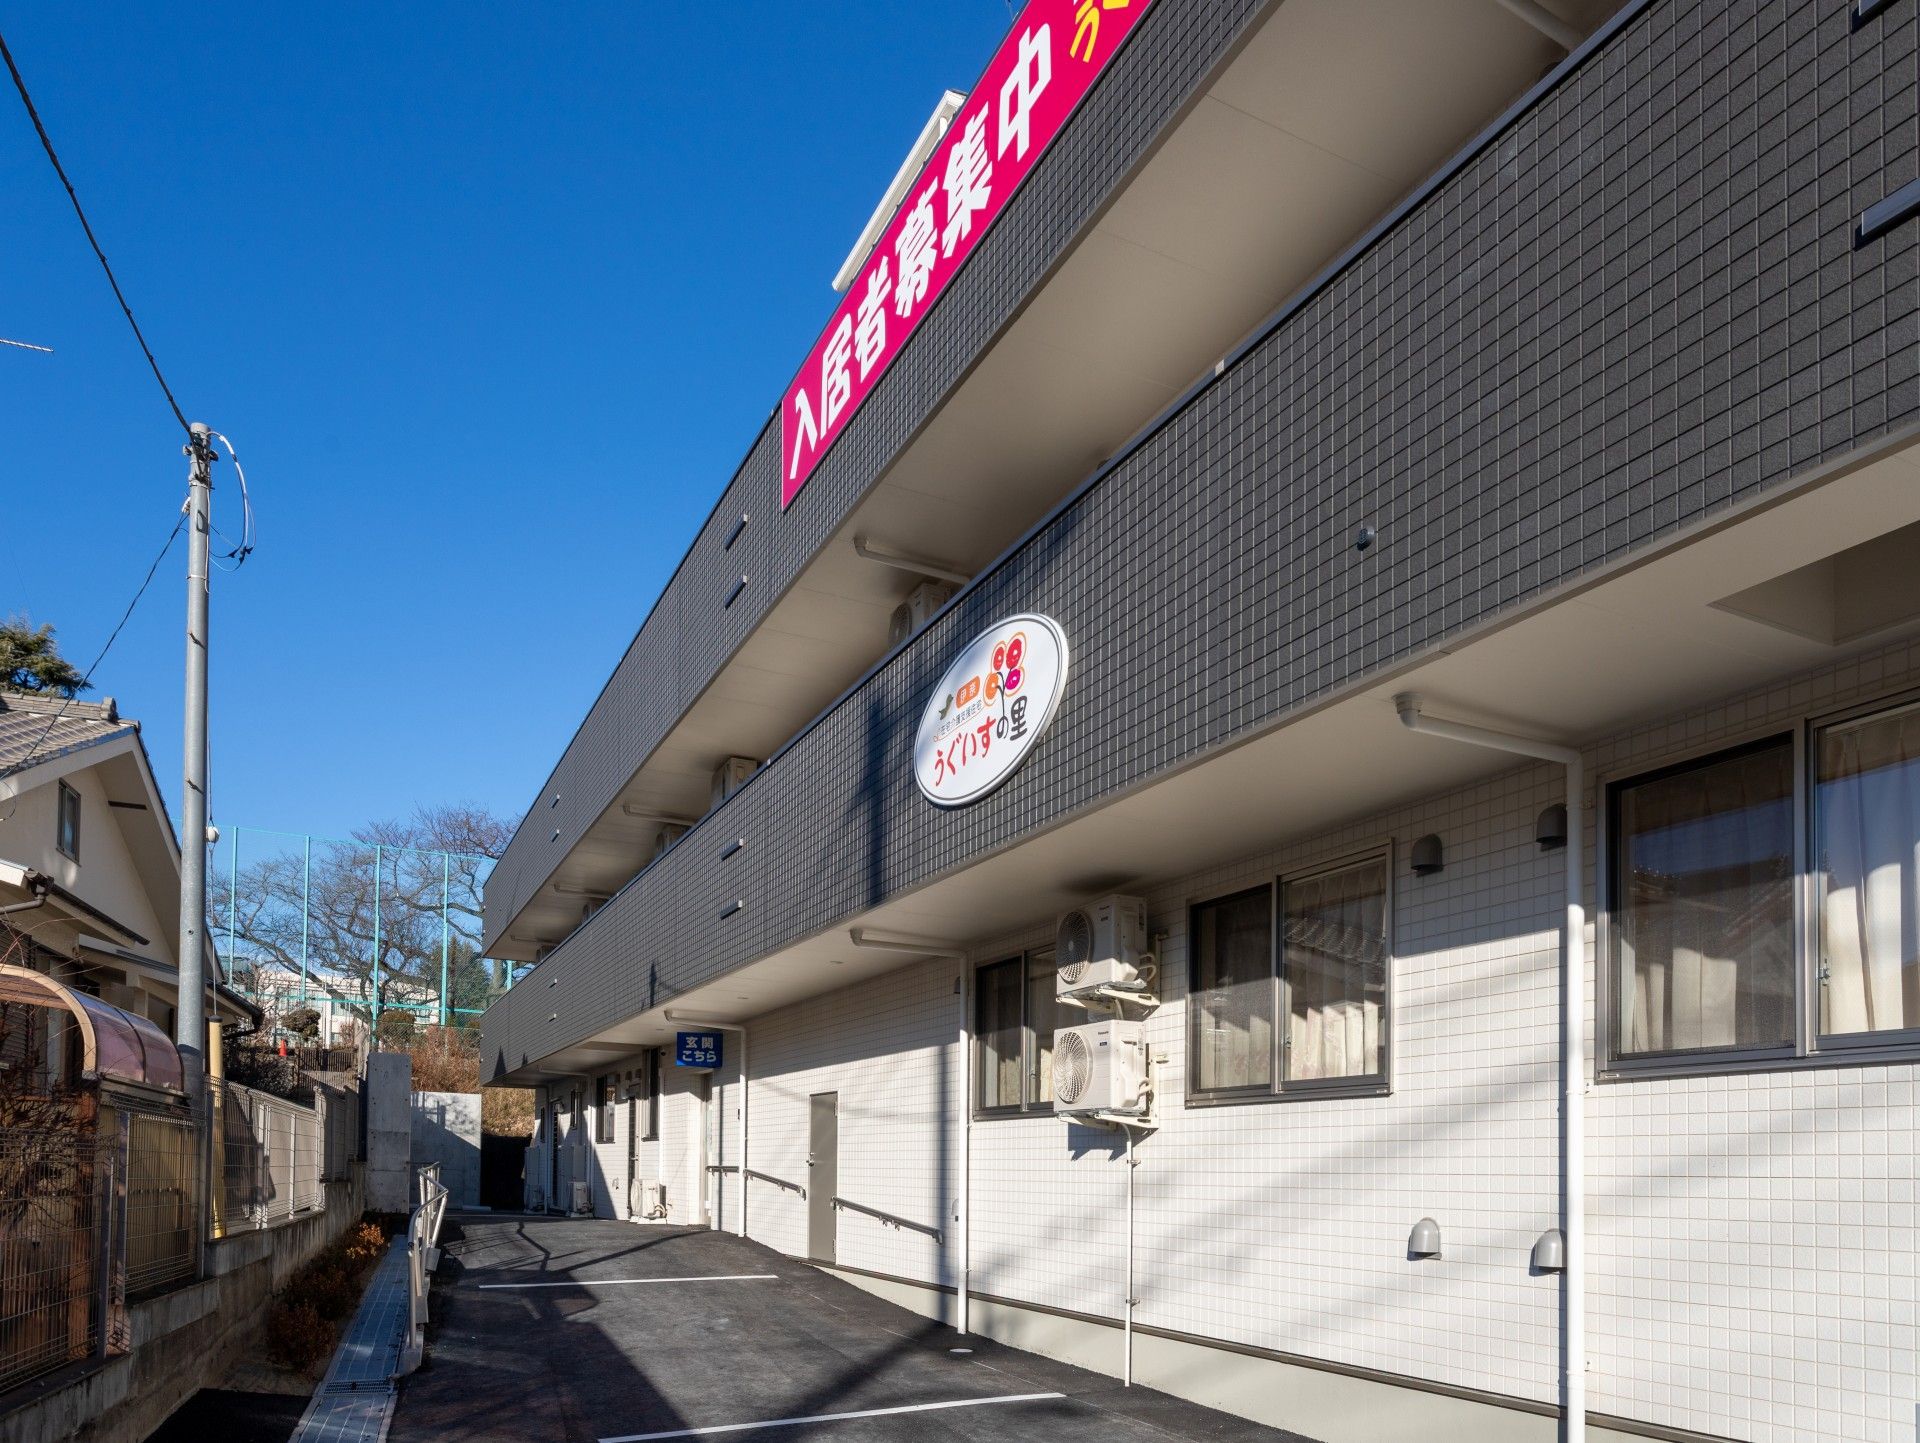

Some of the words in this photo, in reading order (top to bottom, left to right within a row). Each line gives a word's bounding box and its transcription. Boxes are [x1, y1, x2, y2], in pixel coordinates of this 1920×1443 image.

[789, 23, 1052, 480] 入居者募集中
[935, 695, 1028, 786] うぐいすの里
[682, 1050, 717, 1063] こちら
[685, 1036, 714, 1049] 玄関
